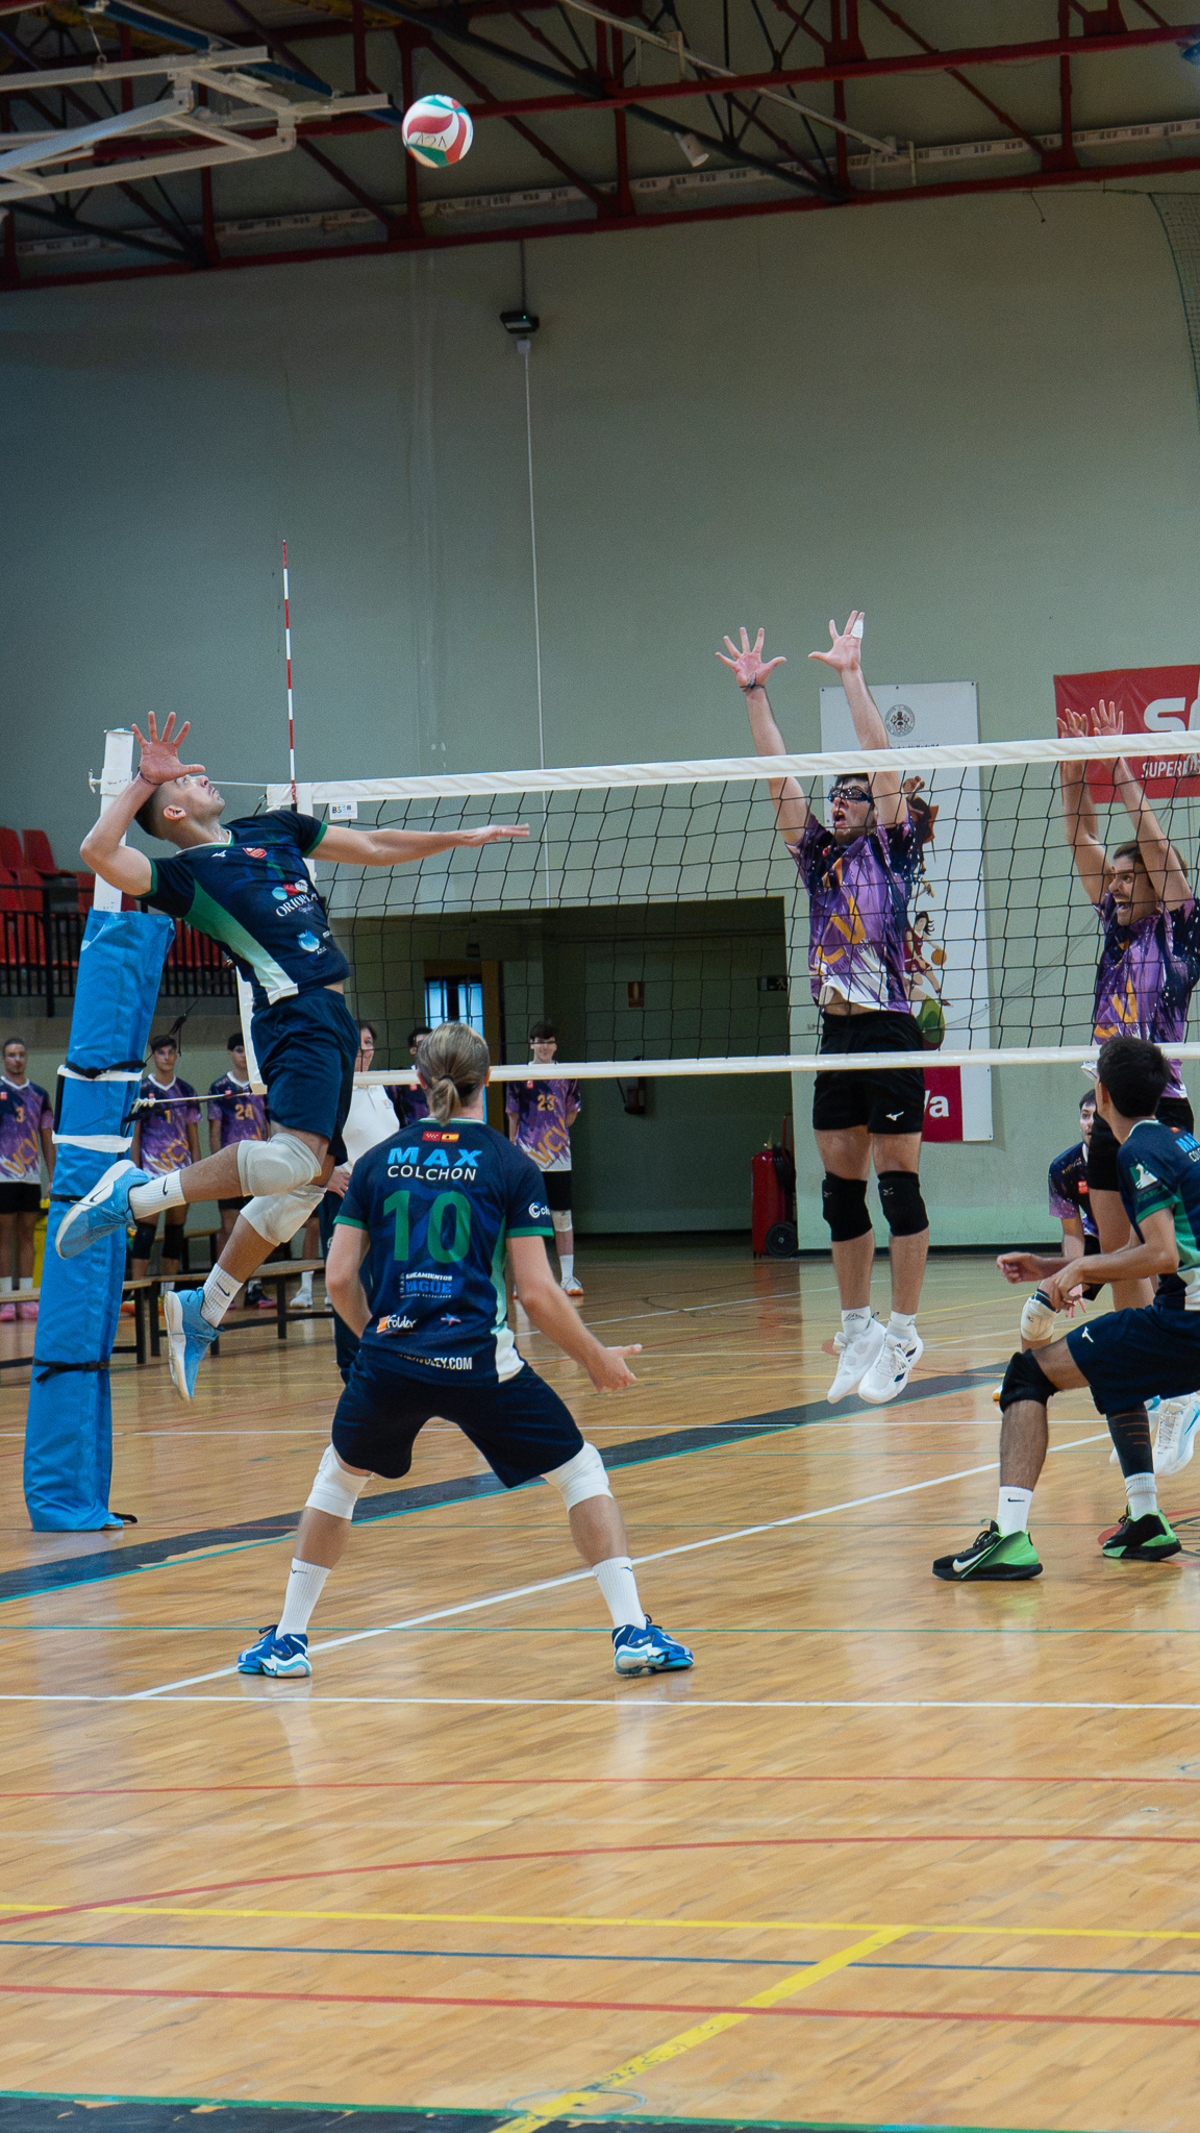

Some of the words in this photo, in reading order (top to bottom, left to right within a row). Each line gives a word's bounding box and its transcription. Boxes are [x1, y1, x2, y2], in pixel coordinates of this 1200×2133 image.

[234, 1103, 254, 1120] 24
[537, 1094, 555, 1111] 23
[15, 1106, 25, 1122] 3
[528, 1116, 568, 1164] VCV
[4, 1129, 39, 1175] VCV
[387, 1146, 483, 1168] MAX
[387, 1165, 477, 1181] COLCHON
[383, 1189, 471, 1264] 10
